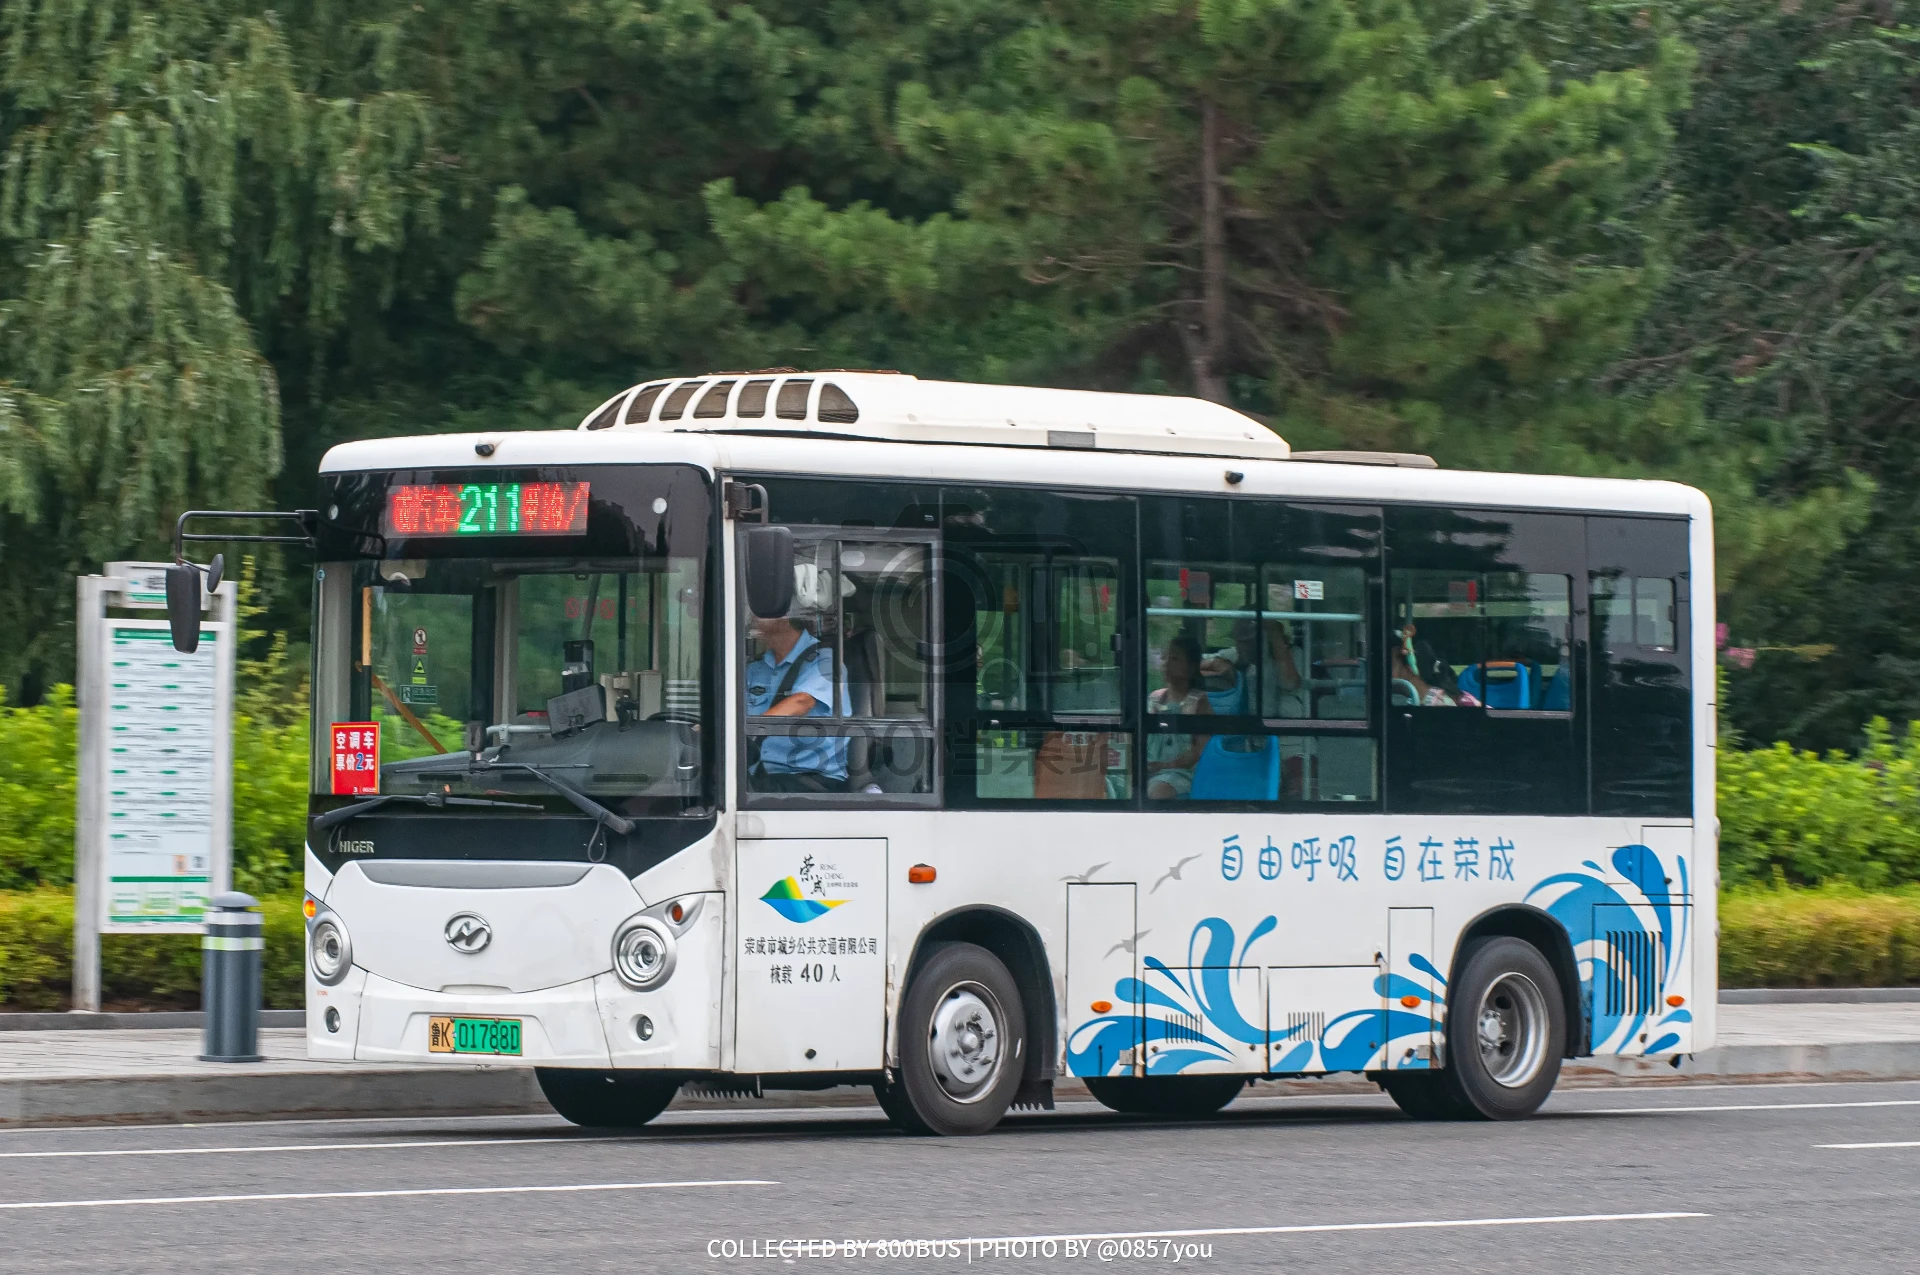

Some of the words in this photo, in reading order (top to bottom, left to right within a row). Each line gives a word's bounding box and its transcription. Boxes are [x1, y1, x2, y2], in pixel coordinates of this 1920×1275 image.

[459, 485, 519, 532] 211
[335, 731, 375, 750] 空调车
[335, 752, 375, 771] 票价2元
[339, 840, 375, 853] HIGER
[1220, 834, 1360, 882] 自由呼吸
[1383, 835, 1516, 882] 自在荣成
[744, 936, 878, 956] 荣成市城乡公共交通有限公司
[800, 963, 824, 983] 40
[829, 964, 841, 983] 人
